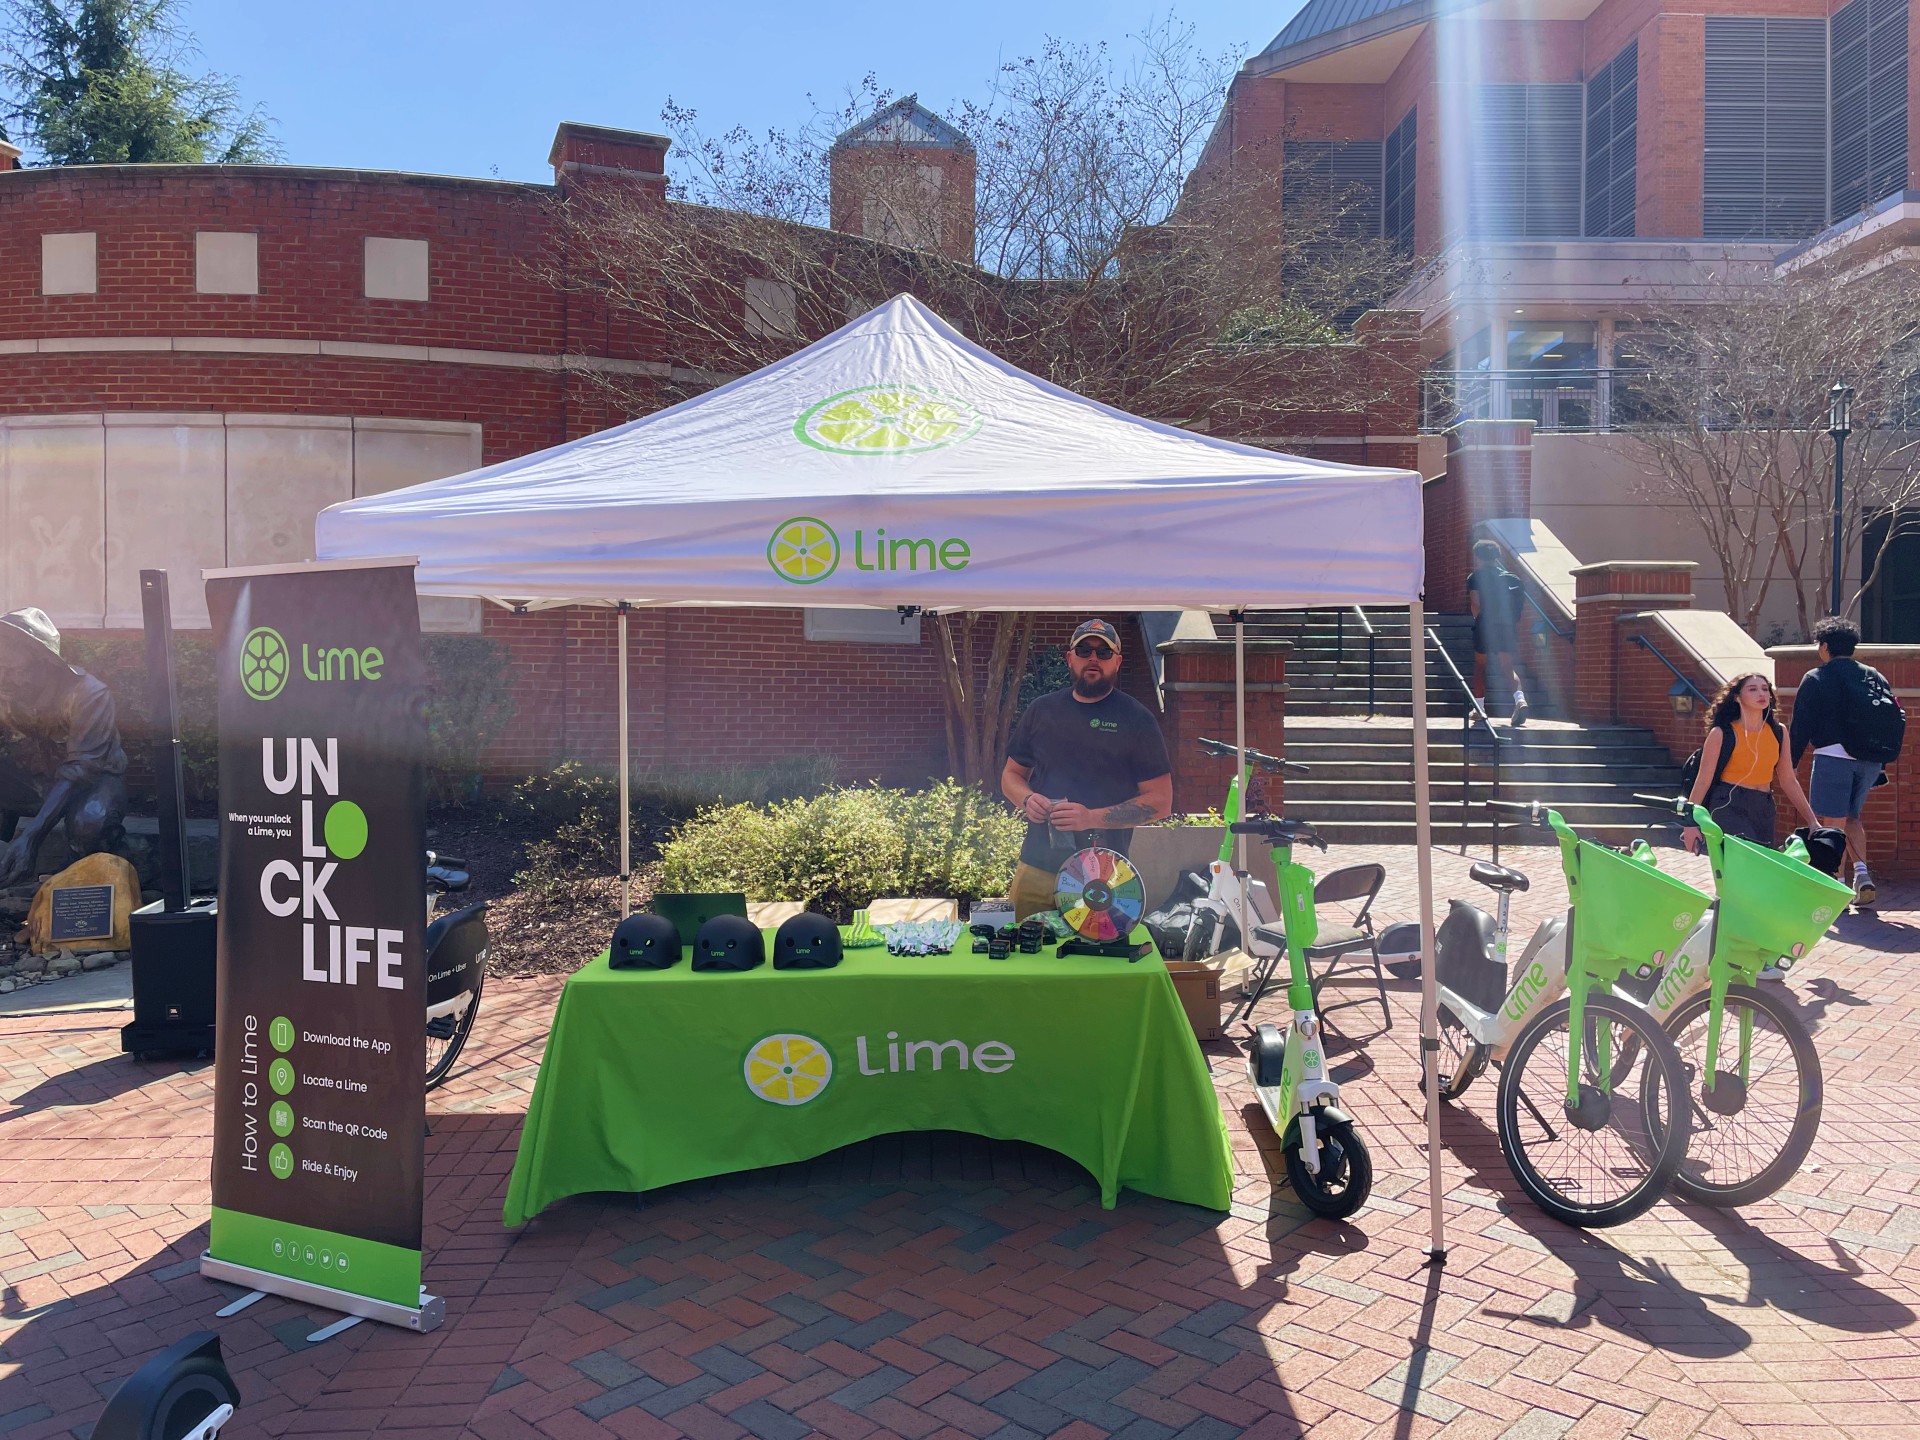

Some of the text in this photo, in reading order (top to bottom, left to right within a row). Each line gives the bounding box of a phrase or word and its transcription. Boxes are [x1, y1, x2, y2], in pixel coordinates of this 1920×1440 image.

[855, 528, 971, 571] Lime
[302, 643, 385, 682] Lime
[262, 737, 339, 796] UN
[228, 812, 292, 825] When you unlock
[247, 826, 292, 840] a Lime, you
[259, 859, 341, 921] CK
[302, 922, 404, 990] LIFE
[428, 974, 438, 982] On
[437, 969, 451, 980] Lime
[455, 963, 467, 973] Uber
[475, 948, 487, 964] Lime
[1504, 963, 1548, 1020] Lime
[1654, 954, 1694, 1010] Lime
[303, 1031, 391, 1054] Download the App
[857, 1031, 1015, 1075] Lime
[240, 1014, 258, 1172] How to Lime
[303, 1073, 368, 1093] Locate a Lime
[302, 1116, 388, 1140] Scan the QR Code
[302, 1160, 358, 1182] Ride & Enjoy
